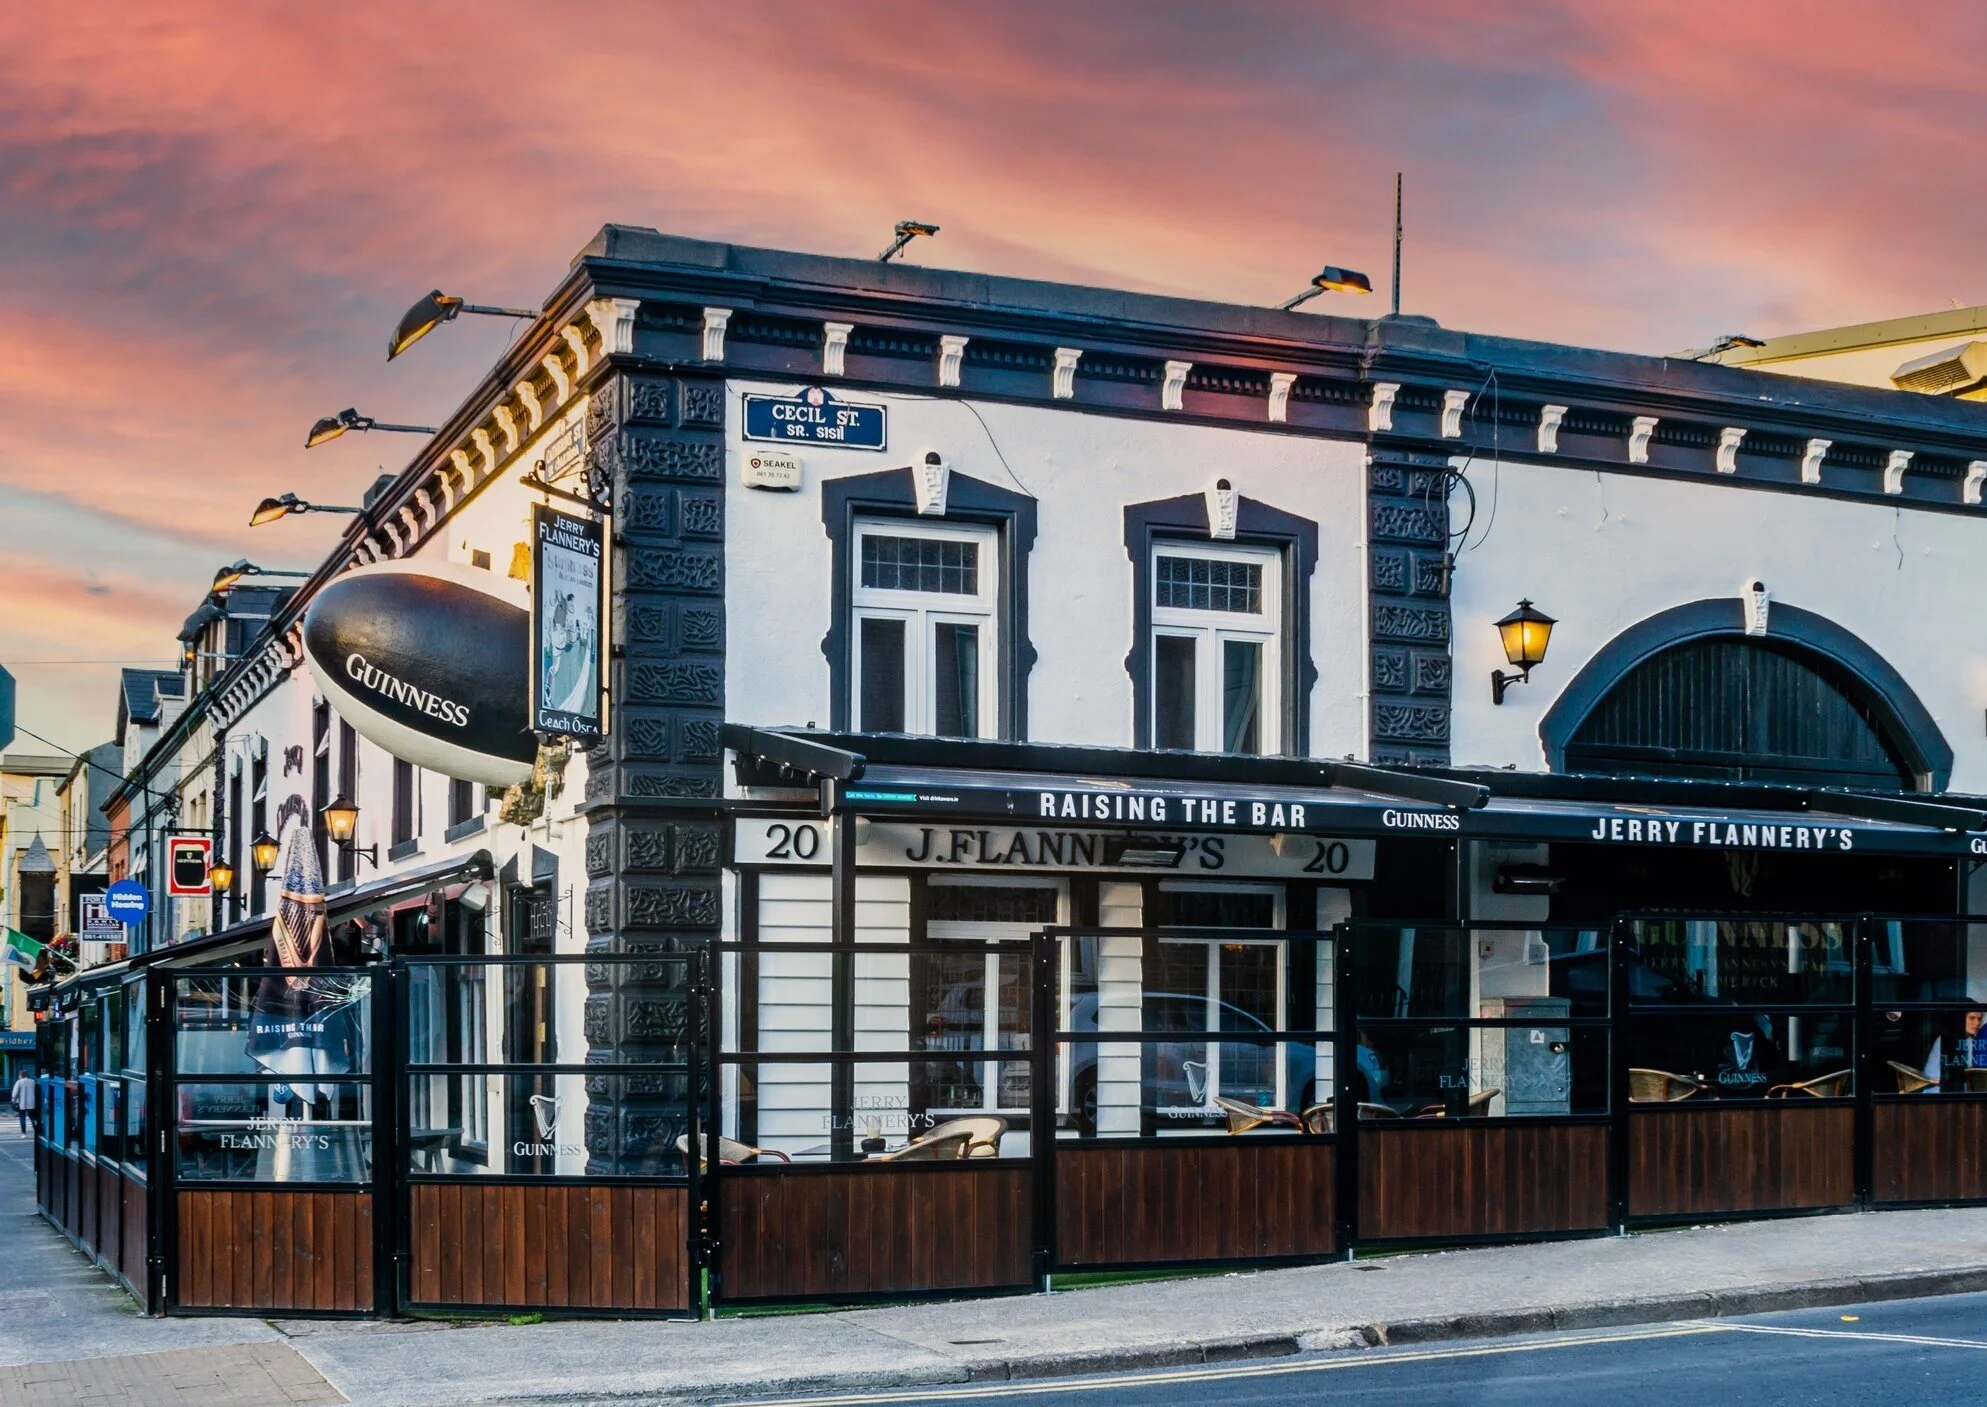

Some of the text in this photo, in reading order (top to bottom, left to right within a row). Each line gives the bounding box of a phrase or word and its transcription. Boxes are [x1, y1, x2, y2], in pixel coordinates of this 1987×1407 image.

[772, 404, 860, 427] CECIL ST.
[786, 425, 809, 437] SR.
[763, 460, 797, 470] SEAKEL
[553, 515, 585, 536] JERRY
[539, 521, 600, 557] FLANNERY'S
[345, 653, 470, 727] GUINNESS
[538, 709, 570, 732] Teach
[1040, 793, 1306, 828] RAISING THE BAR
[1382, 809, 1460, 830] GUINNESS
[765, 823, 819, 860] 20
[1592, 818, 1853, 850] JERRY FLANNERY'S
[1303, 841, 1349, 875] 20
[256, 1023, 296, 1034] RAISING
[1718, 1071, 1768, 1085] GUINNESS
[850, 1096, 907, 1110] JERRY
[246, 1116, 303, 1131] JERRY
[821, 1113, 936, 1130] FLANNERY'S
[513, 1141, 582, 1156] GUINNESS
